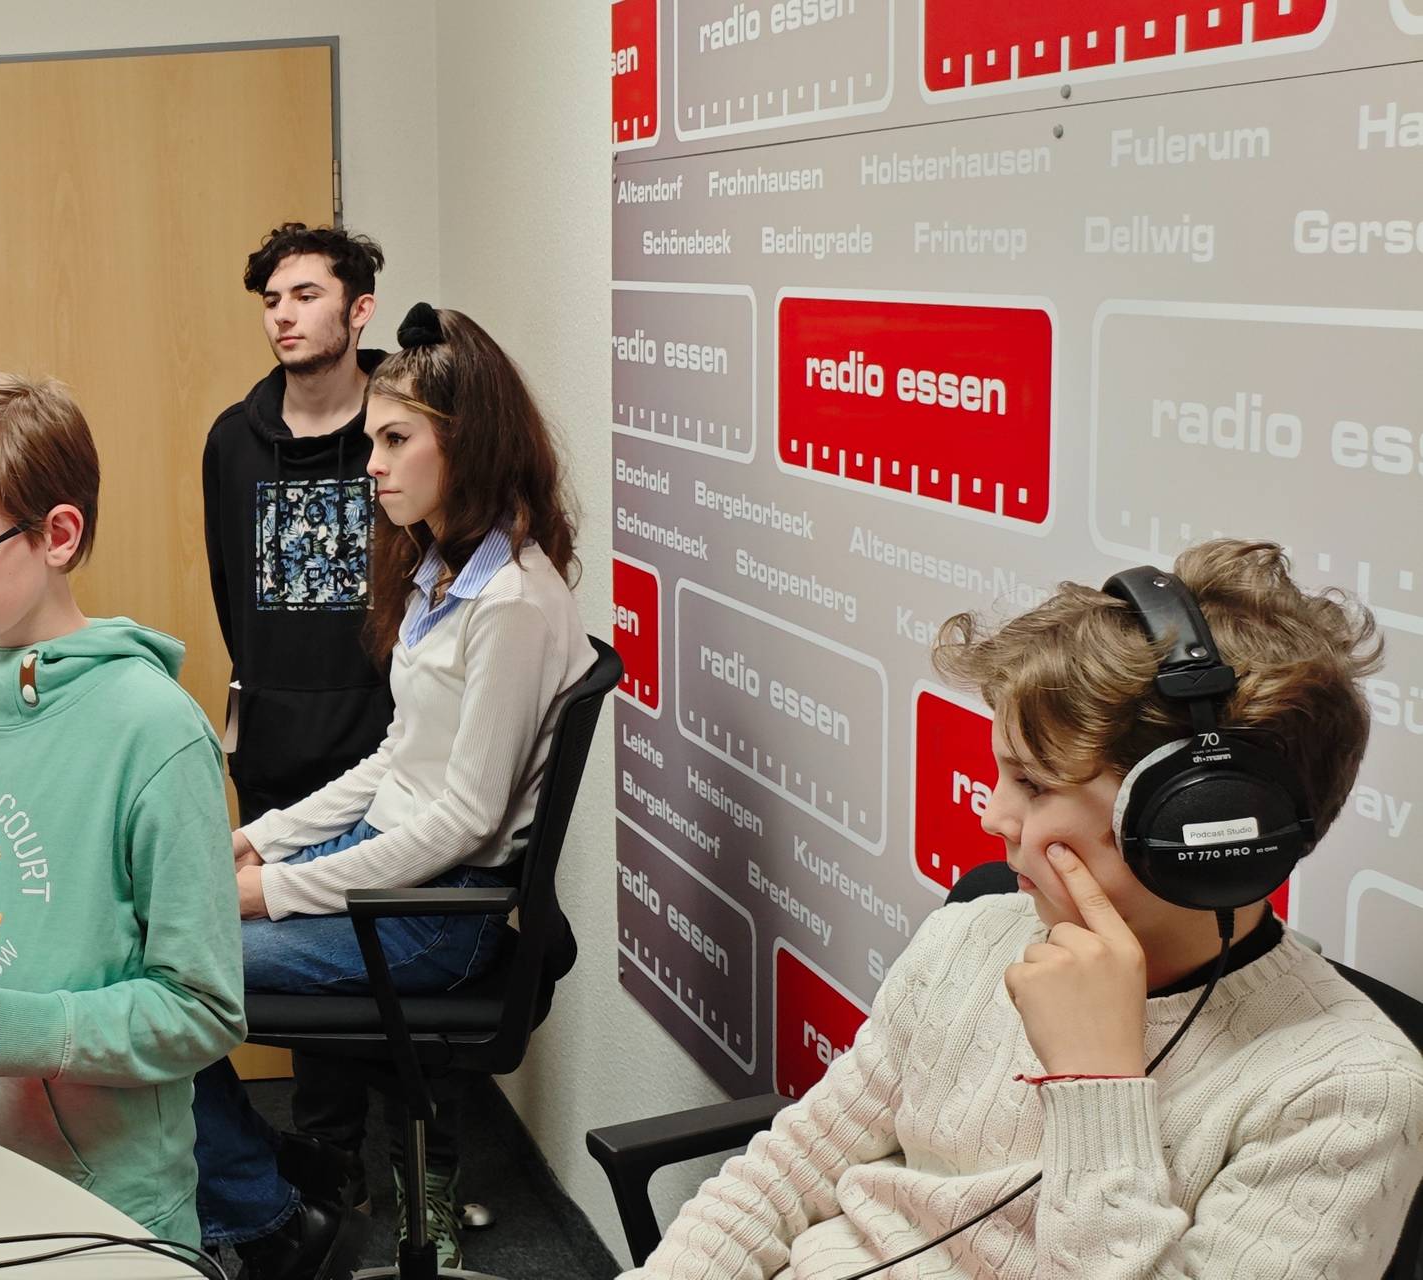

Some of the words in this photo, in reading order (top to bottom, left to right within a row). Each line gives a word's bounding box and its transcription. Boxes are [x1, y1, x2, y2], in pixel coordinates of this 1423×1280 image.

[699, 3, 761, 53] radio
[617, 174, 683, 204] Altendorf
[708, 166, 823, 198] Frohnhausen
[861, 146, 1051, 186] Holsterhausen
[1110, 125, 1271, 168] Fulerum
[643, 229, 731, 255] Schönebeck
[761, 224, 873, 260] Bedingrade
[913, 220, 1027, 260] Frintrop
[1084, 213, 1215, 263] Dellwig
[1293, 209, 1423, 254] Gers
[664, 341, 728, 375] essen
[805, 350, 884, 398] radio
[896, 366, 1007, 416] essen
[1151, 392, 1303, 459] radio
[615, 458, 670, 495] Bochold
[694, 479, 814, 540] Bergeborbeck
[616, 507, 709, 561] Schonnebeck
[735, 548, 857, 624] Stoppenberg
[700, 645, 760, 698] radio
[769, 679, 850, 746] essen
[1197, 732, 1220, 747] 70
[622, 723, 664, 771] Leithe
[687, 764, 764, 837] Heisingen
[793, 834, 910, 938] Kupferdreh
[622, 769, 721, 860] Burgaltendorf
[747, 859, 832, 948] Bredeney
[1178, 851, 1194, 861] DT
[1197, 849, 1221, 861] 770
[1224, 846, 1251, 857] PRO
[1190, 829, 1225, 839] Podcast
[1226, 826, 1253, 835] Studio
[667, 904, 729, 977] essen
